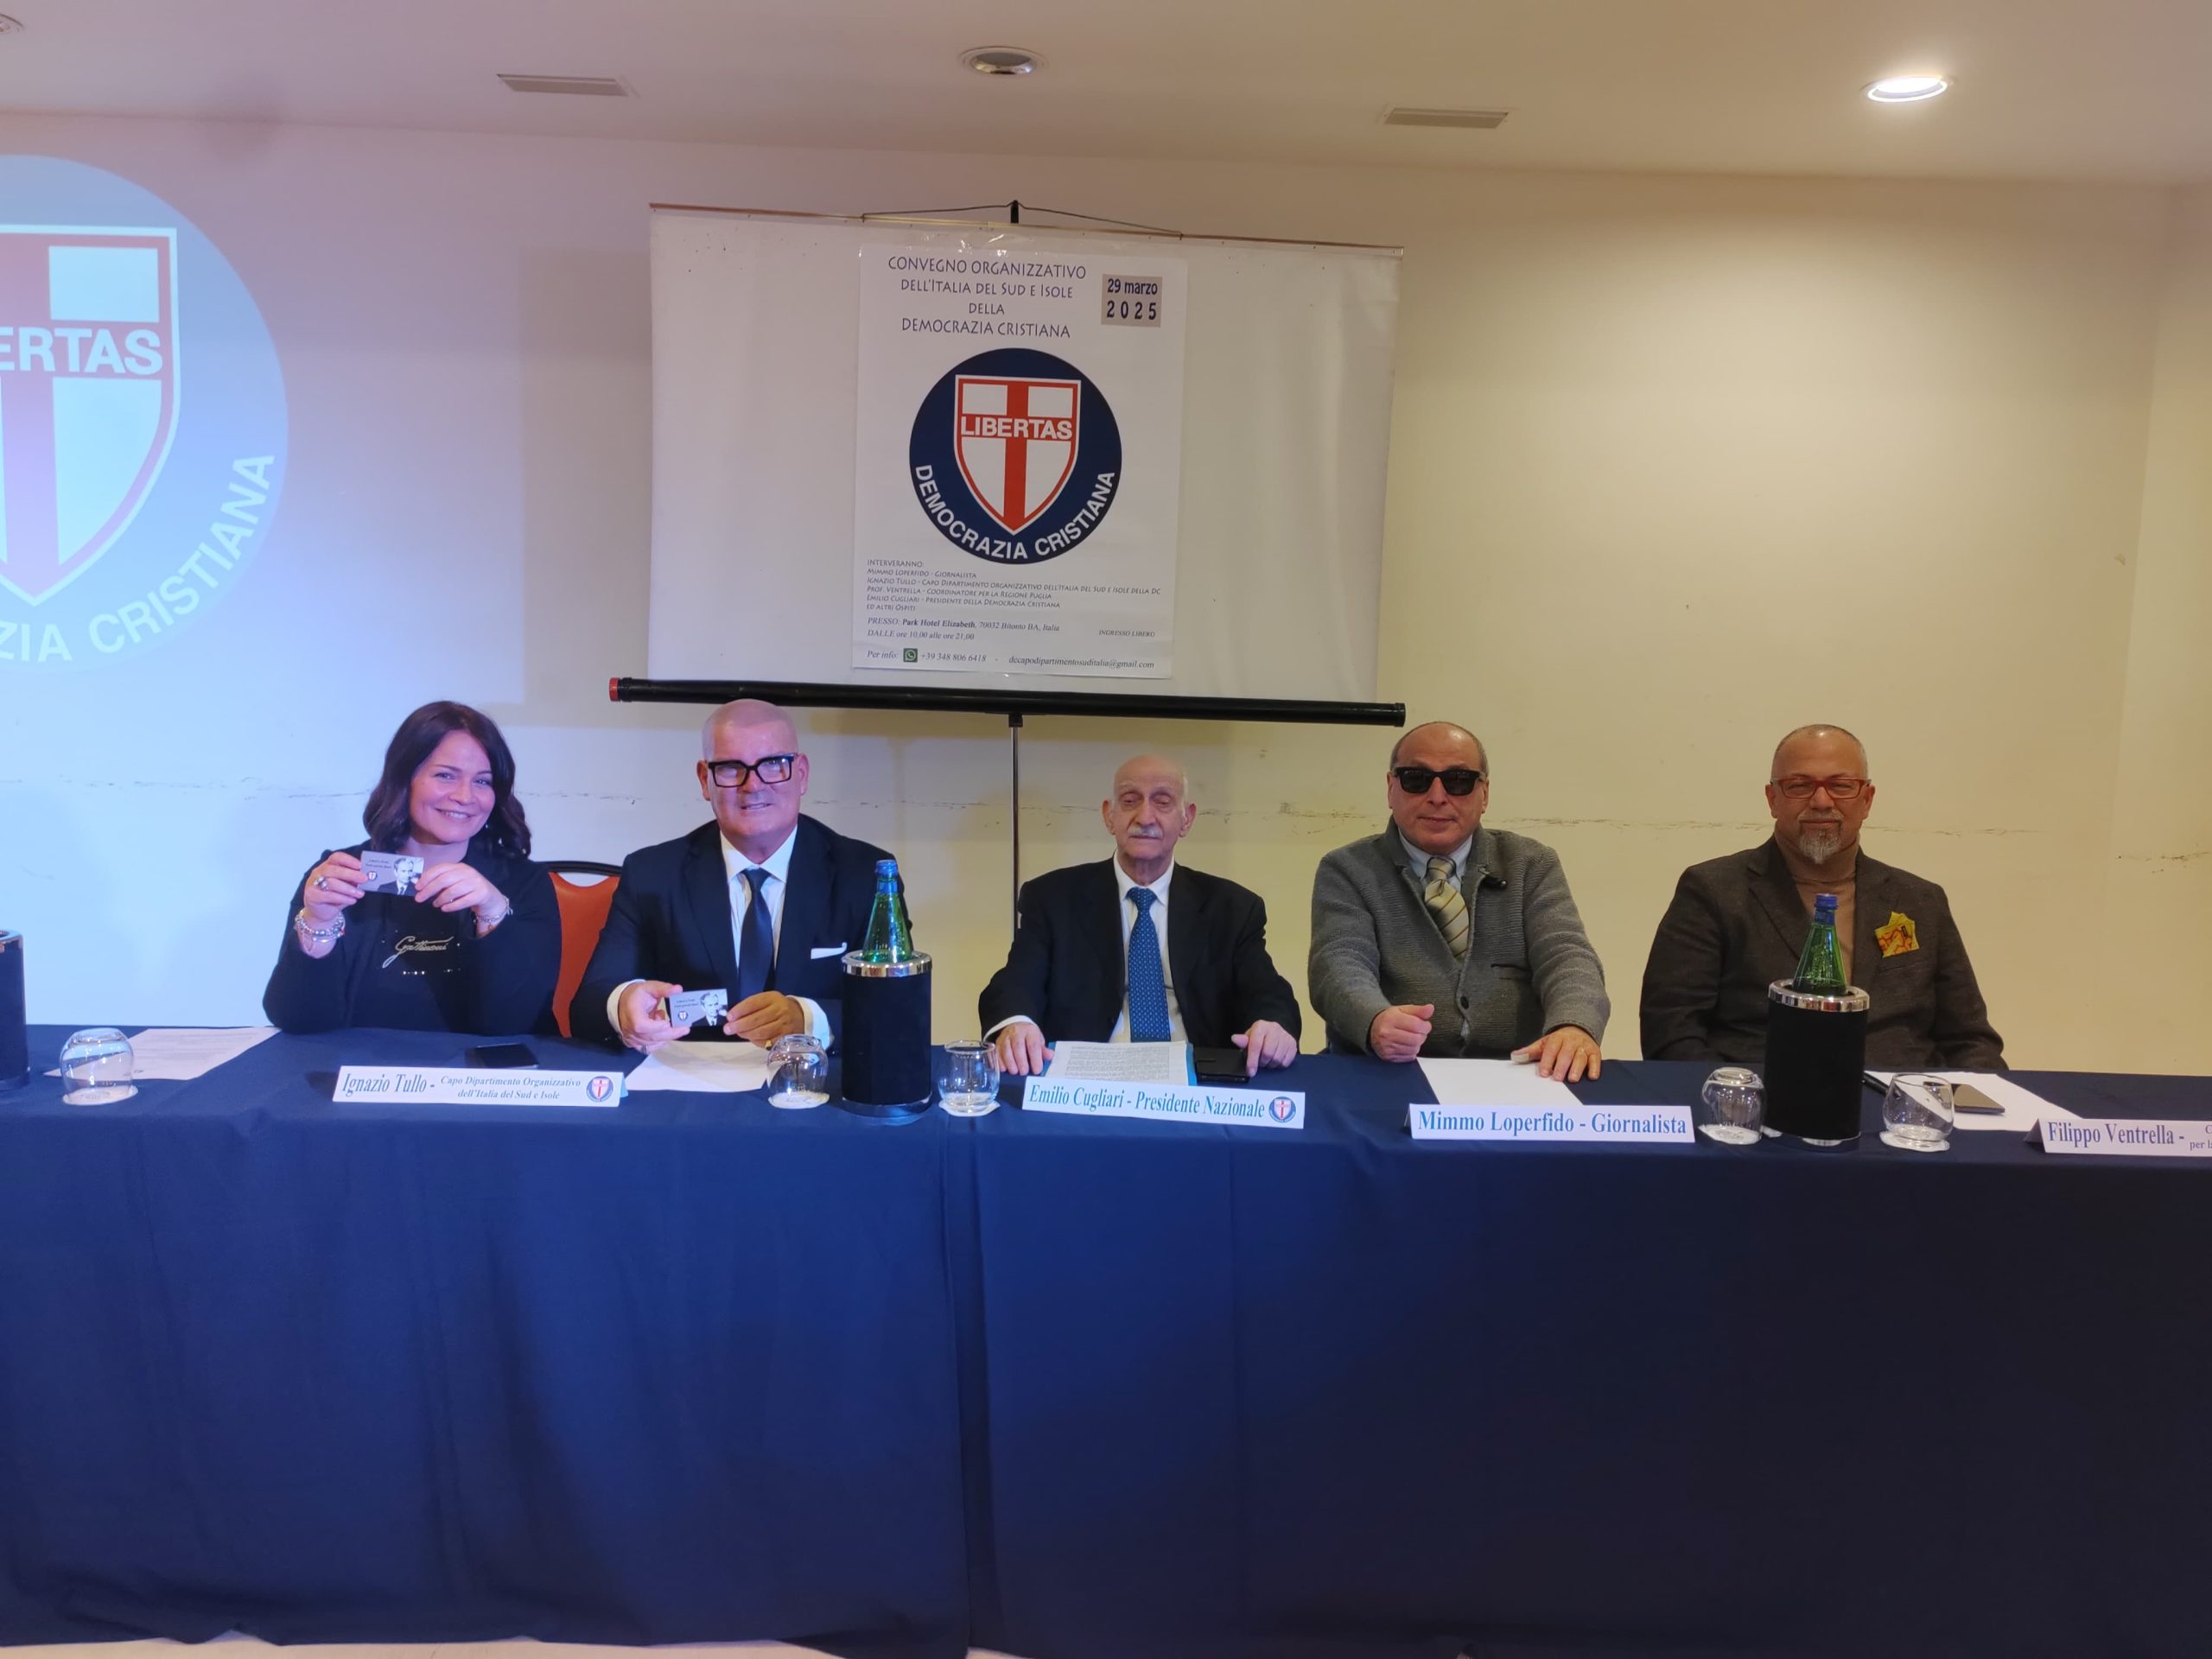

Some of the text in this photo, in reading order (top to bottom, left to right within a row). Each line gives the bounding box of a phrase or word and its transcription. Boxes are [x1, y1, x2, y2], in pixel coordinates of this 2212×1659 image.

[888, 256, 1086, 279] CONVEGNO ORGANIZZATIVO
[901, 278, 1073, 298] DELL'ITALIA DEL SUD E ISOLE
[1108, 278, 1158, 296] 29 marzo
[969, 302, 1005, 315] DELLA
[902, 318, 1071, 338] DEMOCRAZIA CRISTIANA
[960, 416, 1072, 441] LIBERTAS
[915, 465, 1116, 560] DEMOCRAZIA CRISTIANA
[88, 455, 276, 654] CRISTIANA
[867, 559, 925, 568] INTERVERANNO:
[935, 570, 976, 579] GIORNALISTA
[926, 588, 976, 597] COORDINATORE
[941, 580, 989, 588] DIPARTIMENTO
[990, 582, 1042, 591] ORGANIZZATIVO
[925, 596, 962, 605] PRESIDENTE
[983, 598, 1026, 607] DEMOCRAZIA
[937, 652, 951, 661] 348
[342, 1073, 391, 1097] Ignazio
[392, 1073, 427, 1093] Tullo
[441, 1076, 582, 1089] Capo Dipartimento Organizzativo
[500, 1090, 514, 1099] del
[515, 1090, 531, 1099] Sud
[1029, 1084, 1070, 1106] Emilio
[1073, 1087, 1125, 1113] Cugliari
[1135, 1090, 1200, 1115] Presidente
[1203, 1096, 1266, 1118] Nazionale
[1419, 1109, 1484, 1130] Mimmo
[1491, 1111, 1574, 1137] Loperfido
[1592, 1112, 1687, 1134] Giornalista
[2048, 1122, 2101, 1148] Filippo
[2105, 1123, 2174, 1145] Ventrella
[2190, 1141, 2205, 1151] per
